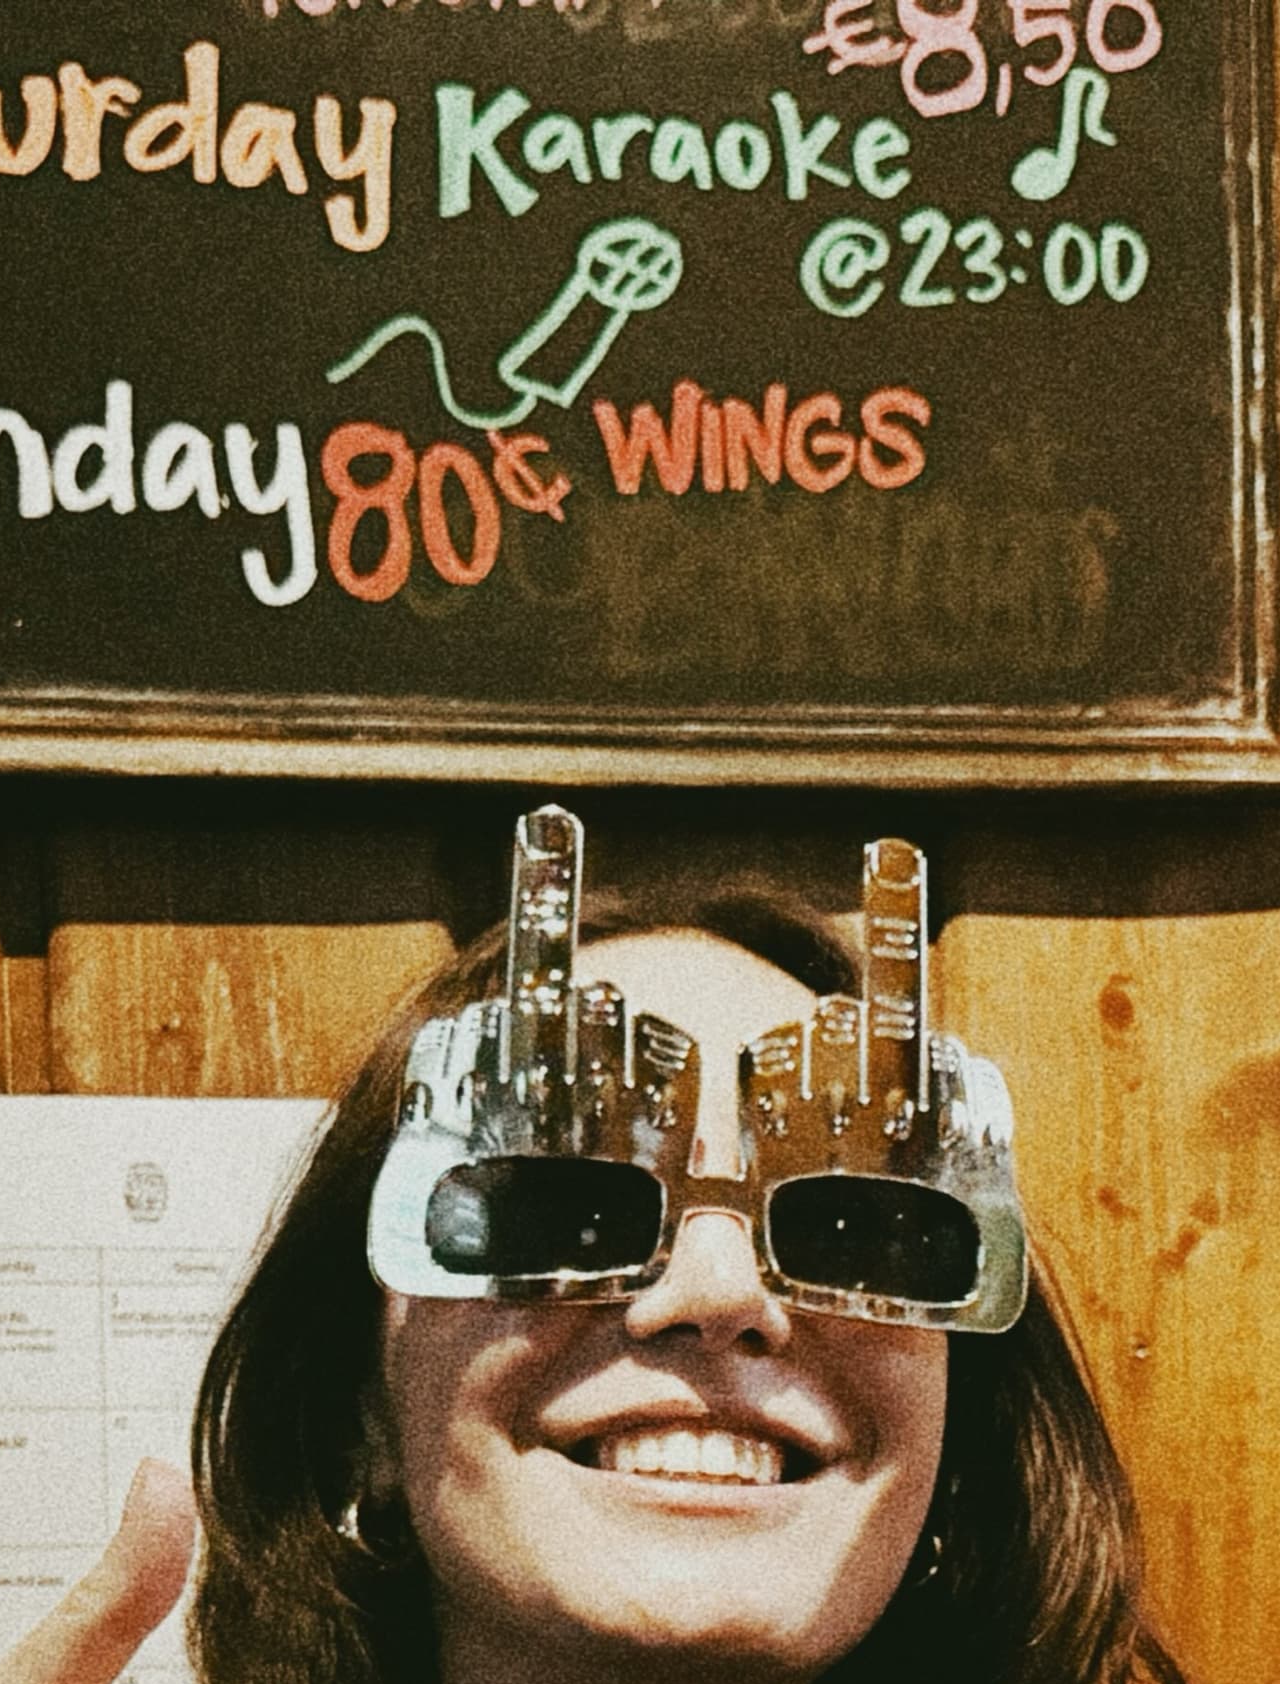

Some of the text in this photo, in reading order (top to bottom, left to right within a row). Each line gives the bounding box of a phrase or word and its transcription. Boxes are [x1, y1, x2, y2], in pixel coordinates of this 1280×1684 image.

[435, 83, 911, 217] Karaoke
[800, 207, 1149, 317] @23:00
[593, 378, 931, 495] WINGS
